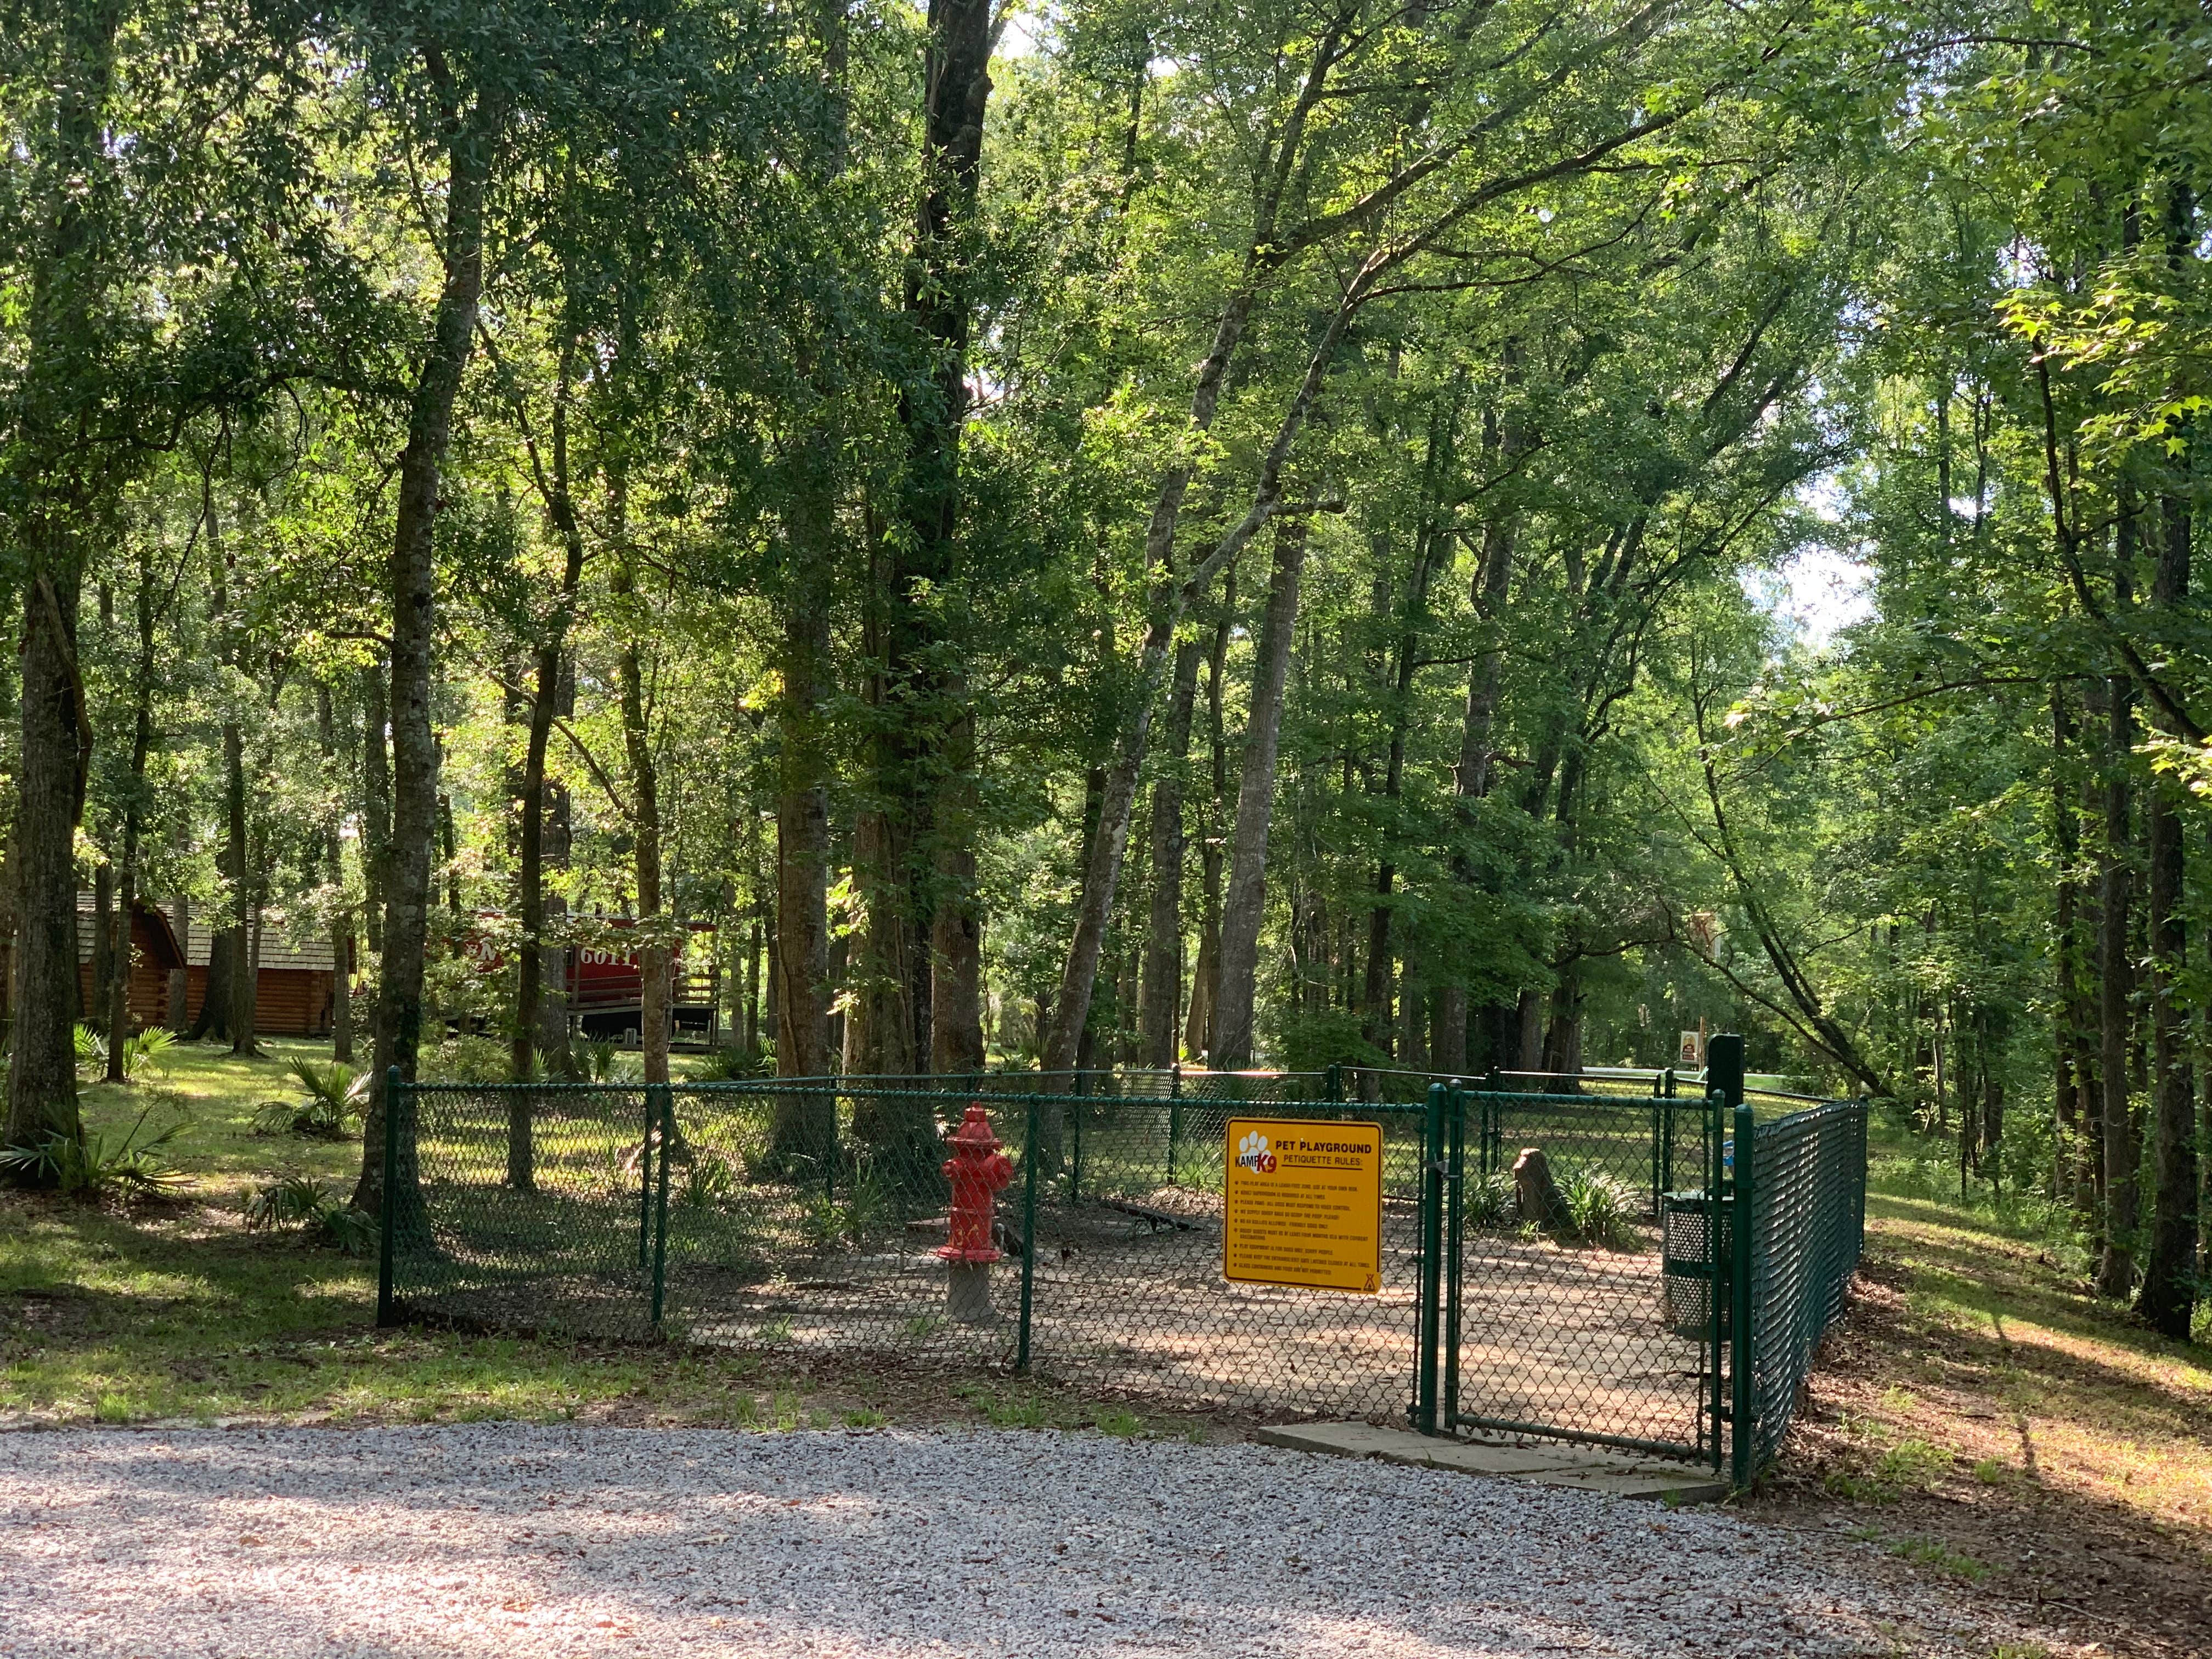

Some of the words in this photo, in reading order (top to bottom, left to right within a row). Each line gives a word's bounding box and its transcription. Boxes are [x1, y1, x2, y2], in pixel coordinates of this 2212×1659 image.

[1276, 1141, 1296, 1150] PET
[1300, 1141, 1372, 1154] PLAYGROUND
[1257, 1153, 1277, 1173] K9
[1284, 1154, 1332, 1165] PETIQUETTE
[1334, 1157, 1363, 1166] RULES:
